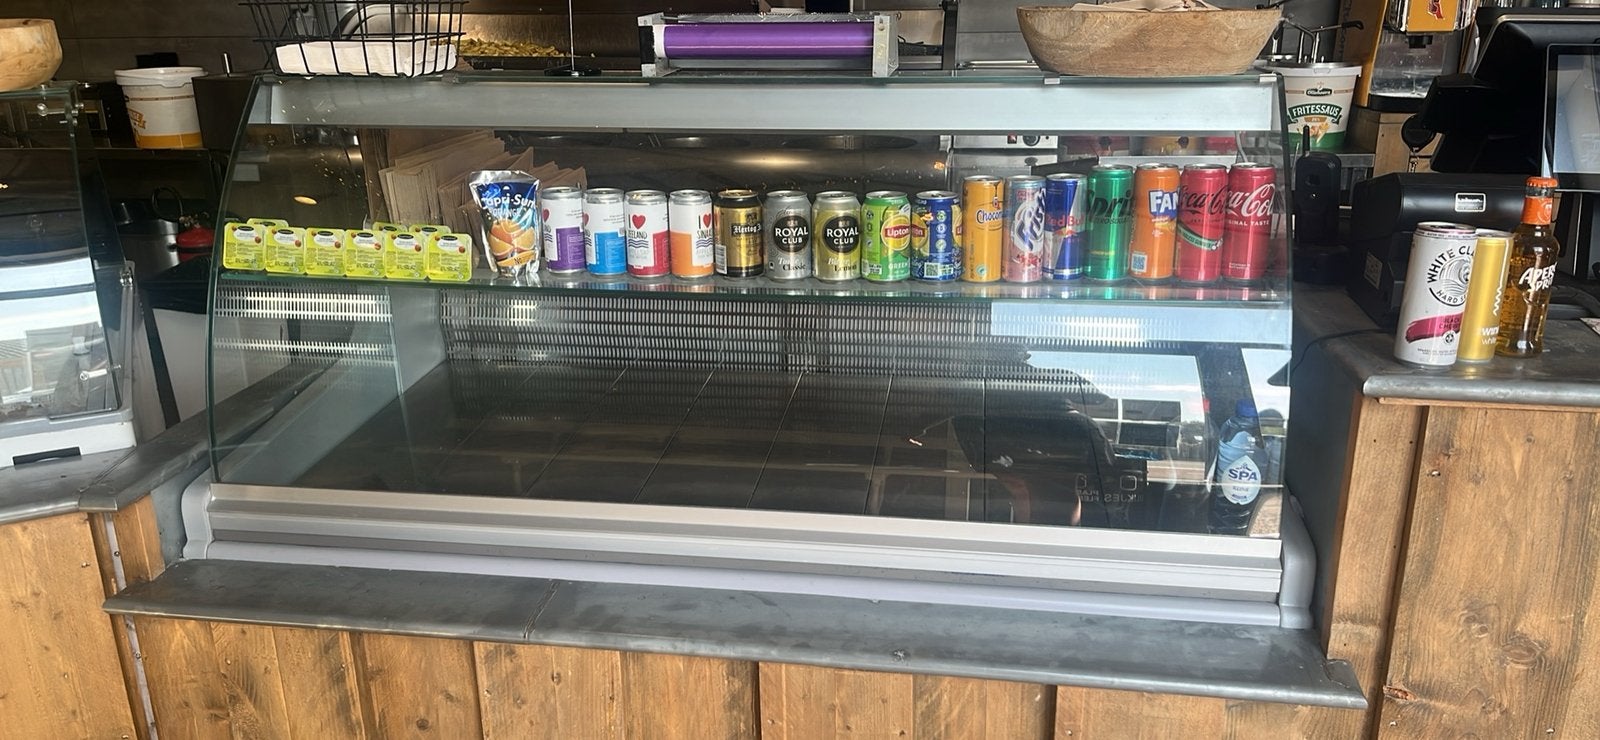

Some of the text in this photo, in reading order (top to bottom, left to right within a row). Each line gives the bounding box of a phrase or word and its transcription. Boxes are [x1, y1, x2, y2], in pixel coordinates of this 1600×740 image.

[1292, 105, 1339, 117] FRITESSAUS
[775, 226, 809, 238] ROYAL
[826, 226, 859, 238] ROYAL
[782, 237, 803, 245] CLUB
[833, 238, 854, 246] CLUB
[1427, 248, 1455, 283] WHITE
[1436, 289, 1458, 304] HARD
[1228, 468, 1258, 481] SPA
